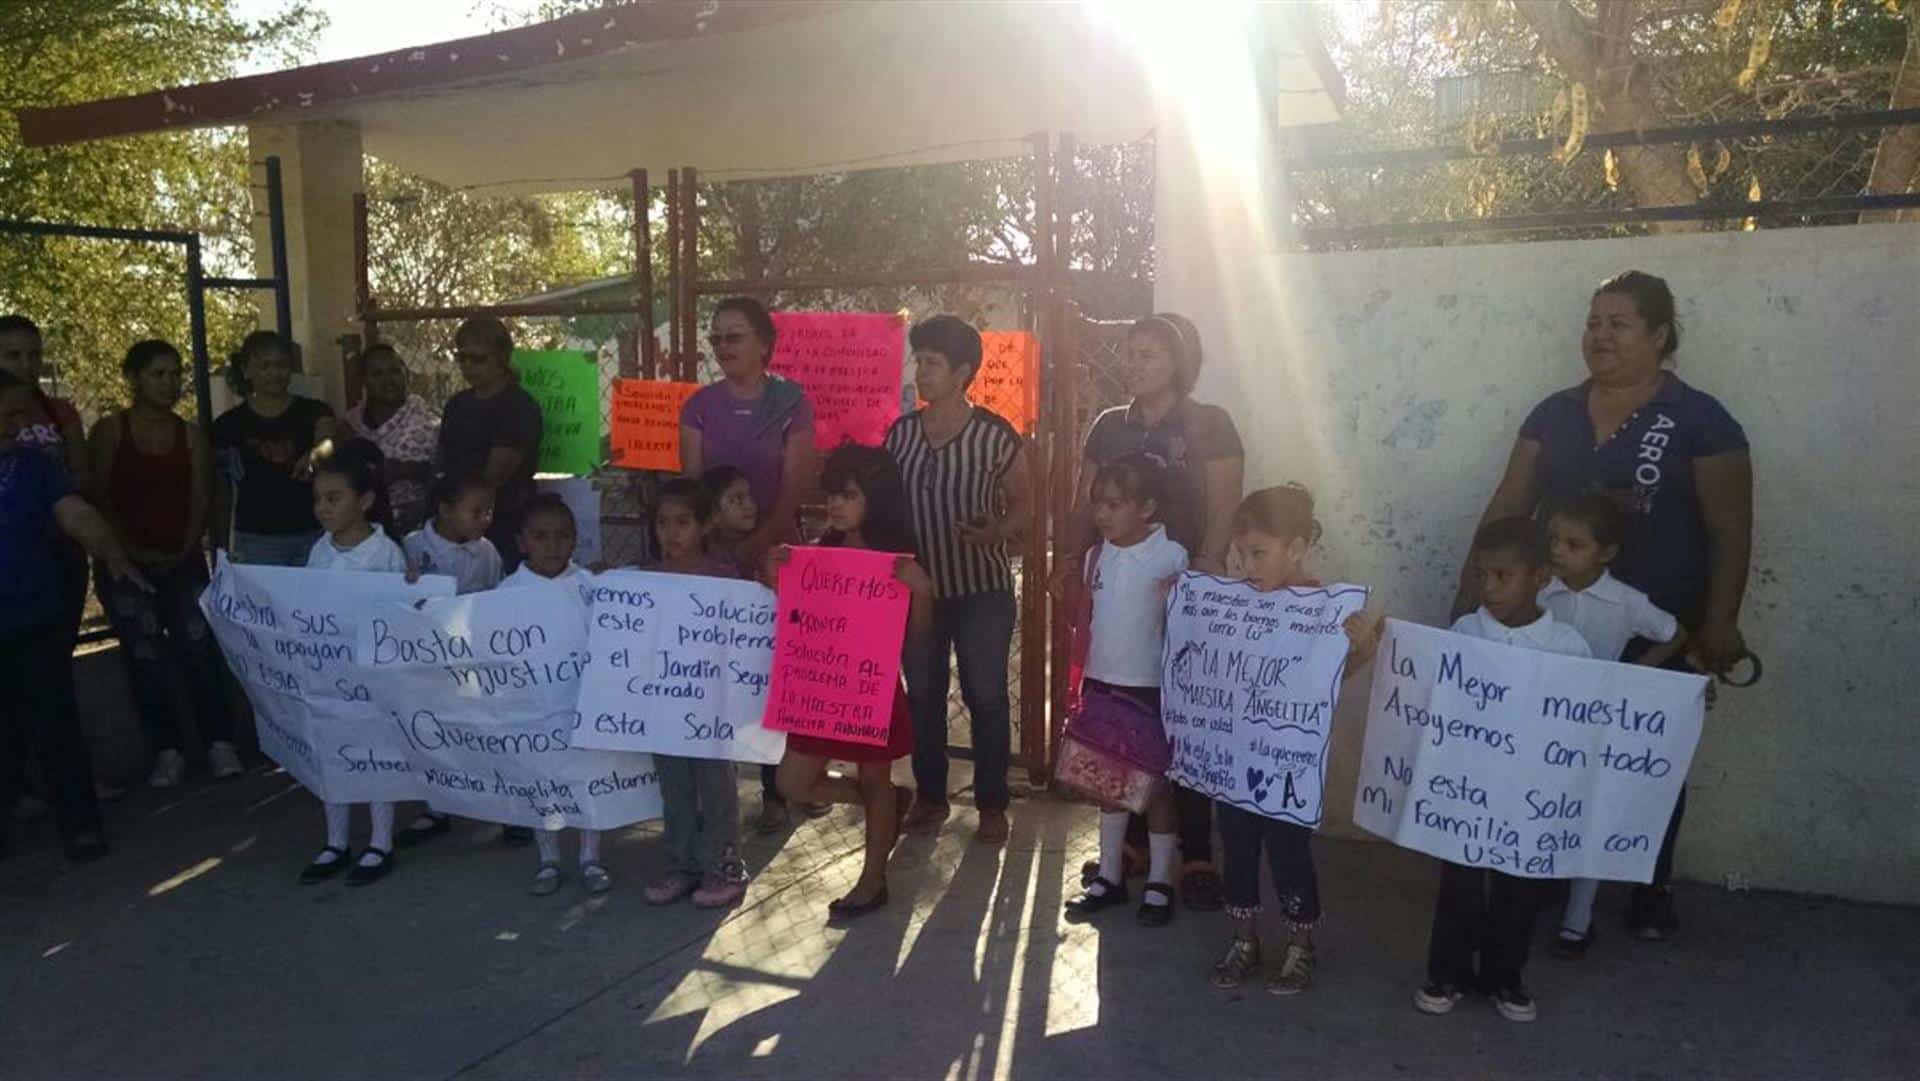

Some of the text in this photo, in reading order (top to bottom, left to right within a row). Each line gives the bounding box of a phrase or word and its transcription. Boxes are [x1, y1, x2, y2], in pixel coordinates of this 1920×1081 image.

[1634, 413, 1676, 486] AERO
[598, 612, 645, 633] este
[372, 619, 547, 666] Basta con
[610, 648, 630, 669] el
[727, 659, 770, 697] Segu
[858, 659, 884, 677] AL
[335, 678, 371, 702] So
[859, 679, 881, 695] DE
[1437, 651, 1511, 712] Mejor
[1542, 696, 1667, 736] maestra
[595, 711, 647, 738] esta
[684, 711, 735, 742] Sola
[1383, 685, 1517, 755] Apoyemos
[1599, 743, 1672, 779] todo
[493, 769, 575, 802] Angelita
[1281, 770, 1307, 810] A
[1383, 755, 1414, 786] No
[1428, 774, 1489, 810] esta
[1535, 829, 1583, 852] esta
[1603, 832, 1650, 852] con
